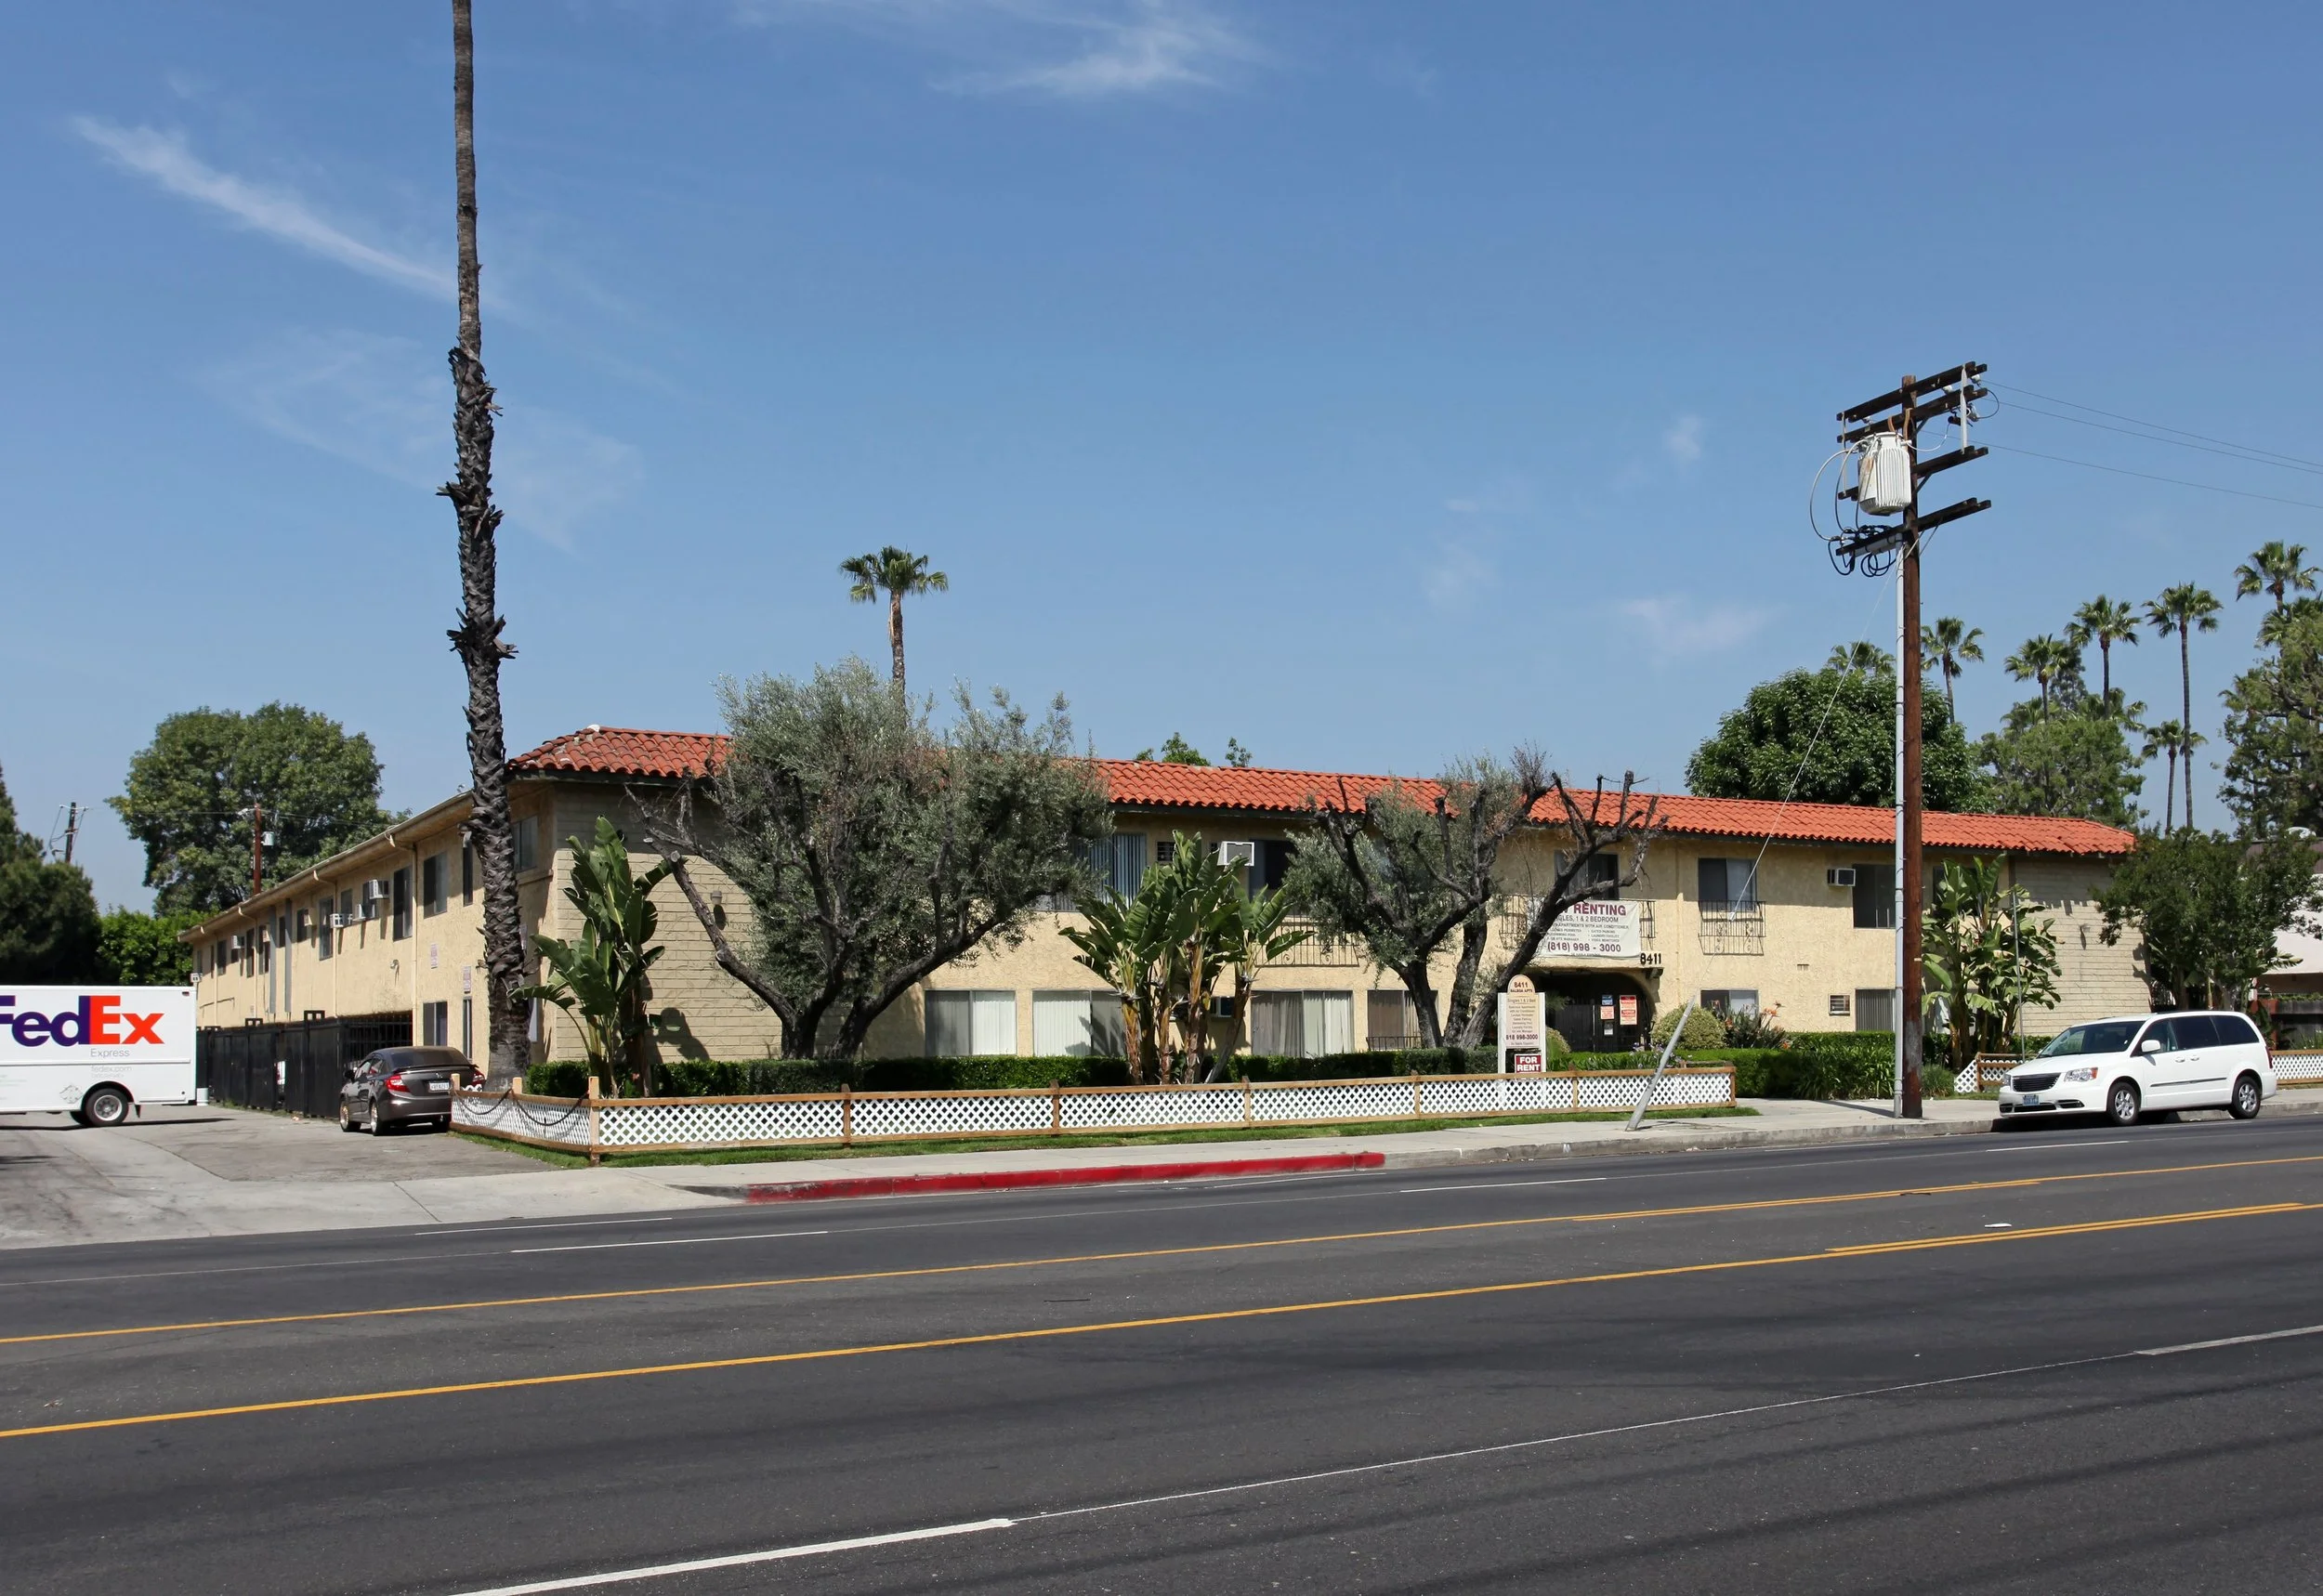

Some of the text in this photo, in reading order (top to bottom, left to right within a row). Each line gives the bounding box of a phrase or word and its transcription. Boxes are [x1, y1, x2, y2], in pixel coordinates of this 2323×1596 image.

[1574, 903, 1626, 916] RENTING
[1548, 942, 1570, 952] (818)
[1573, 943, 1590, 951] 998
[1600, 944, 1621, 952] 3000
[1640, 952, 1661, 965] 8411
[90, 1048, 130, 1059] Express
